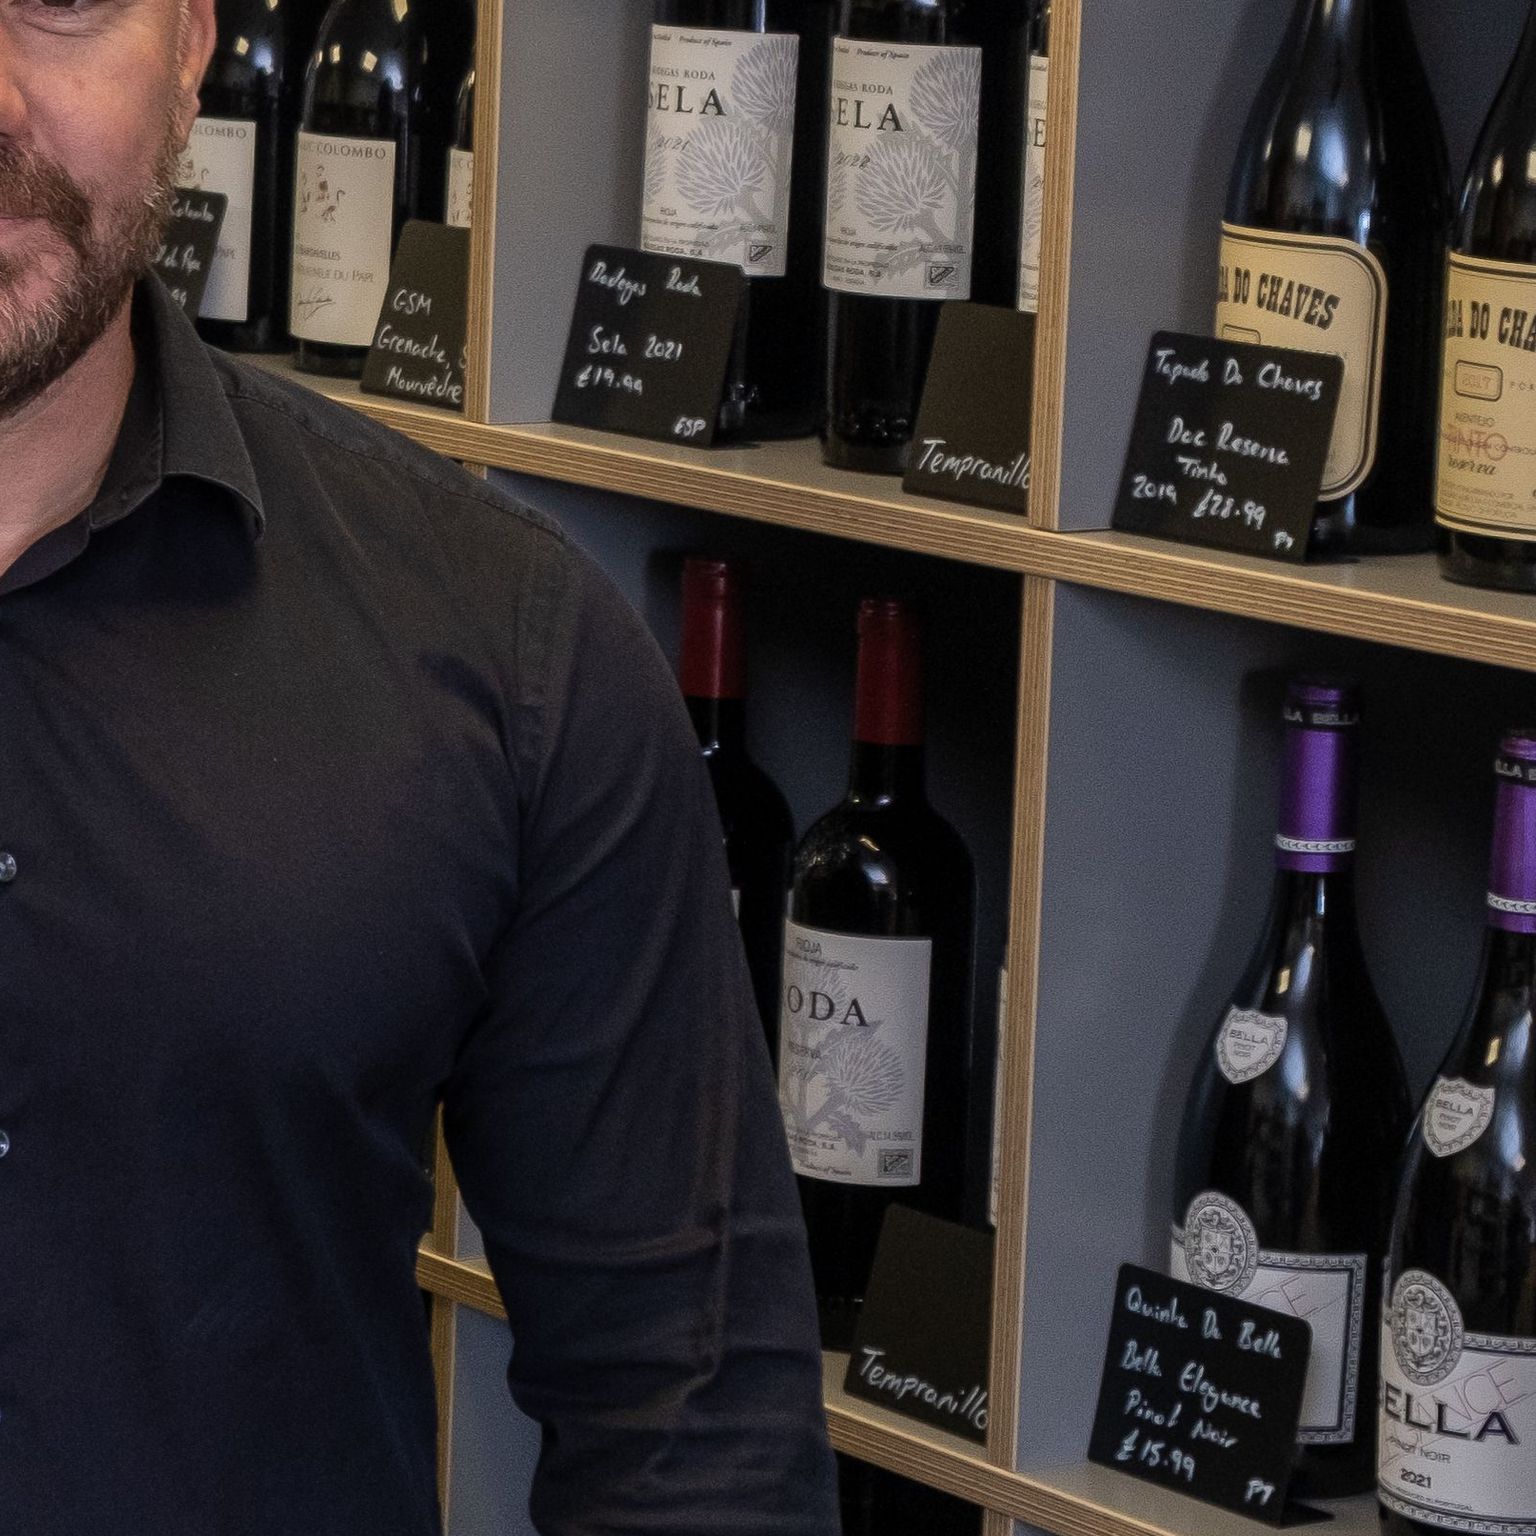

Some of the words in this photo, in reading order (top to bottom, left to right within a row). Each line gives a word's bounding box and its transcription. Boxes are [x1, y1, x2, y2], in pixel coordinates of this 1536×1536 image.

[684, 69, 716, 81] RODA
[861, 84, 894, 95] RODA
[837, 97, 904, 133] ELA
[192, 125, 248, 140] LOMBO
[316, 143, 387, 160] COLOMBO
[666, 266, 703, 297] Roda
[393, 289, 432, 317] GSM
[1233, 266, 1251, 305] DO
[1257, 272, 1341, 331] CHAVES
[1469, 300, 1490, 341] DO
[378, 325, 450, 370] Grenache,
[588, 326, 628, 356] Sela
[643, 335, 683, 361] 2021
[387, 367, 463, 403] Mourvèdre
[1257, 363, 1324, 400] Chaves
[674, 417, 706, 437] ESP
[1132, 475, 1177, 505] 2019
[785, 985, 870, 1027] ODA
[1229, 1028, 1270, 1046] BELLA
[1435, 1098, 1474, 1117] BELLA
[860, 1346, 989, 1430] Tempranillo
[1383, 1379, 1520, 1446] ELLA
[1400, 1467, 1432, 1489] 2021
